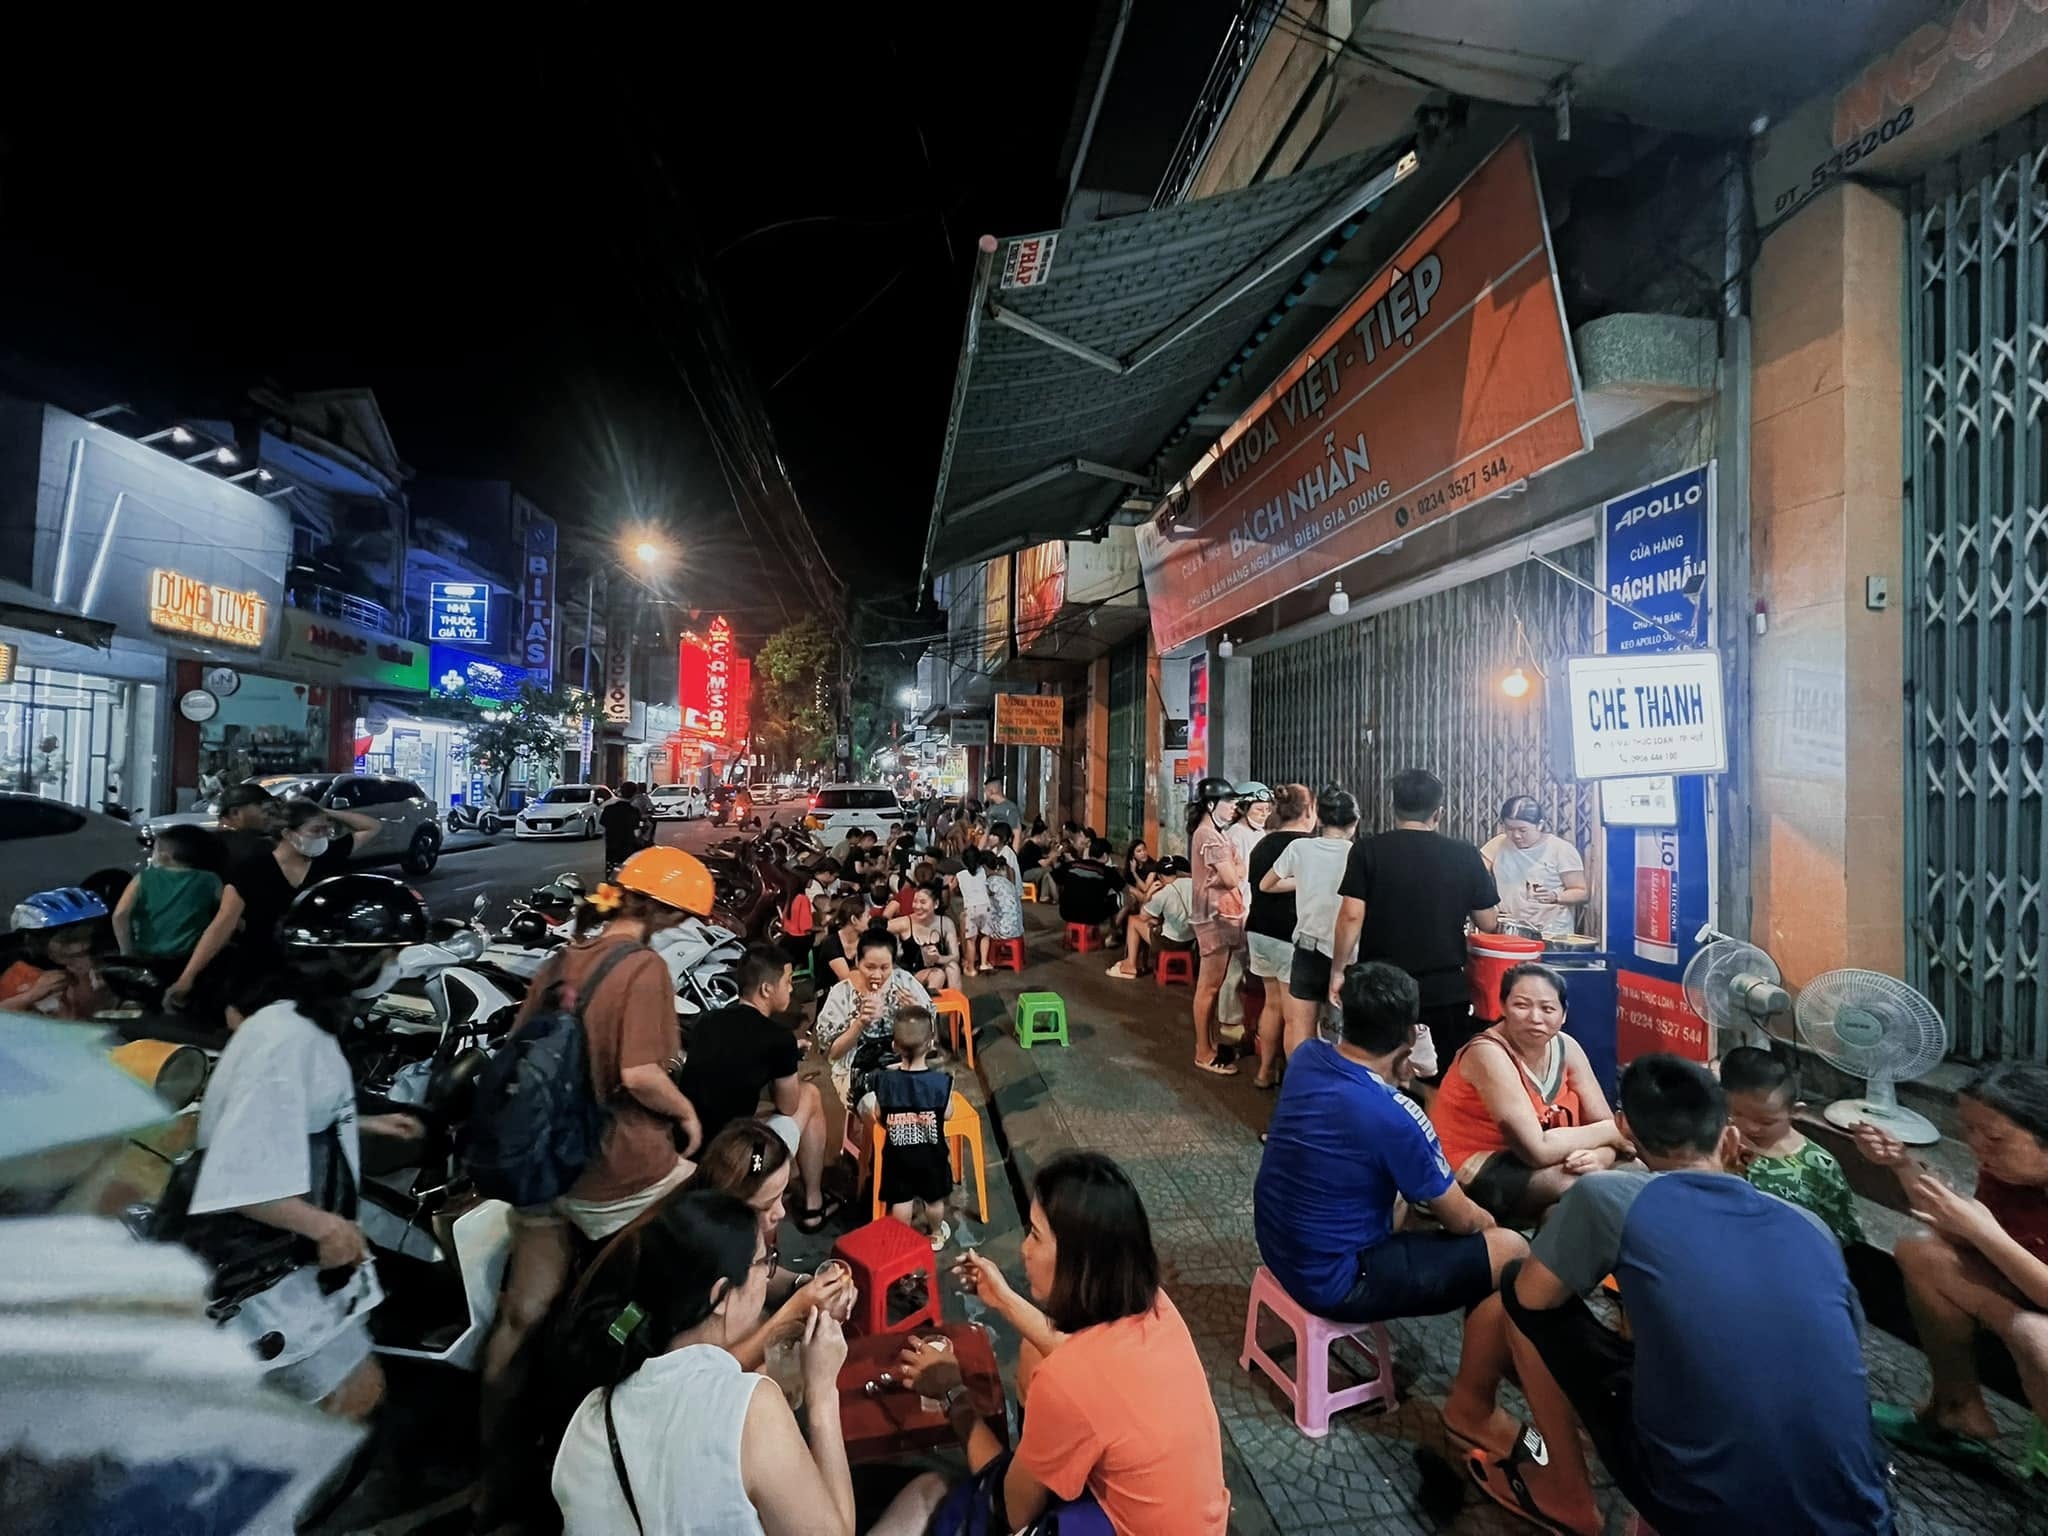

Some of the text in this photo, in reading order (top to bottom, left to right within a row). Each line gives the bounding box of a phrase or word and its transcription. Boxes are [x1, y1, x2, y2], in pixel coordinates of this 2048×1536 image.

[1219, 419, 1280, 489] KHOA
[1280, 346, 1341, 428] VIỆT
[1355, 253, 1442, 364] TIỆP
[1417, 457, 1508, 515] 0234 3527 544
[1615, 485, 1702, 532] APOLLO
[1229, 495, 1285, 560] BÁCH
[1653, 534, 1684, 555] HÀNG
[1611, 575, 1654, 606] BÁCH
[1589, 677, 1704, 731] CHÈ THANH
[1630, 1009, 1653, 1030] 0234
[1656, 1017, 1680, 1038] 3527
[1682, 1026, 1702, 1045] 544
